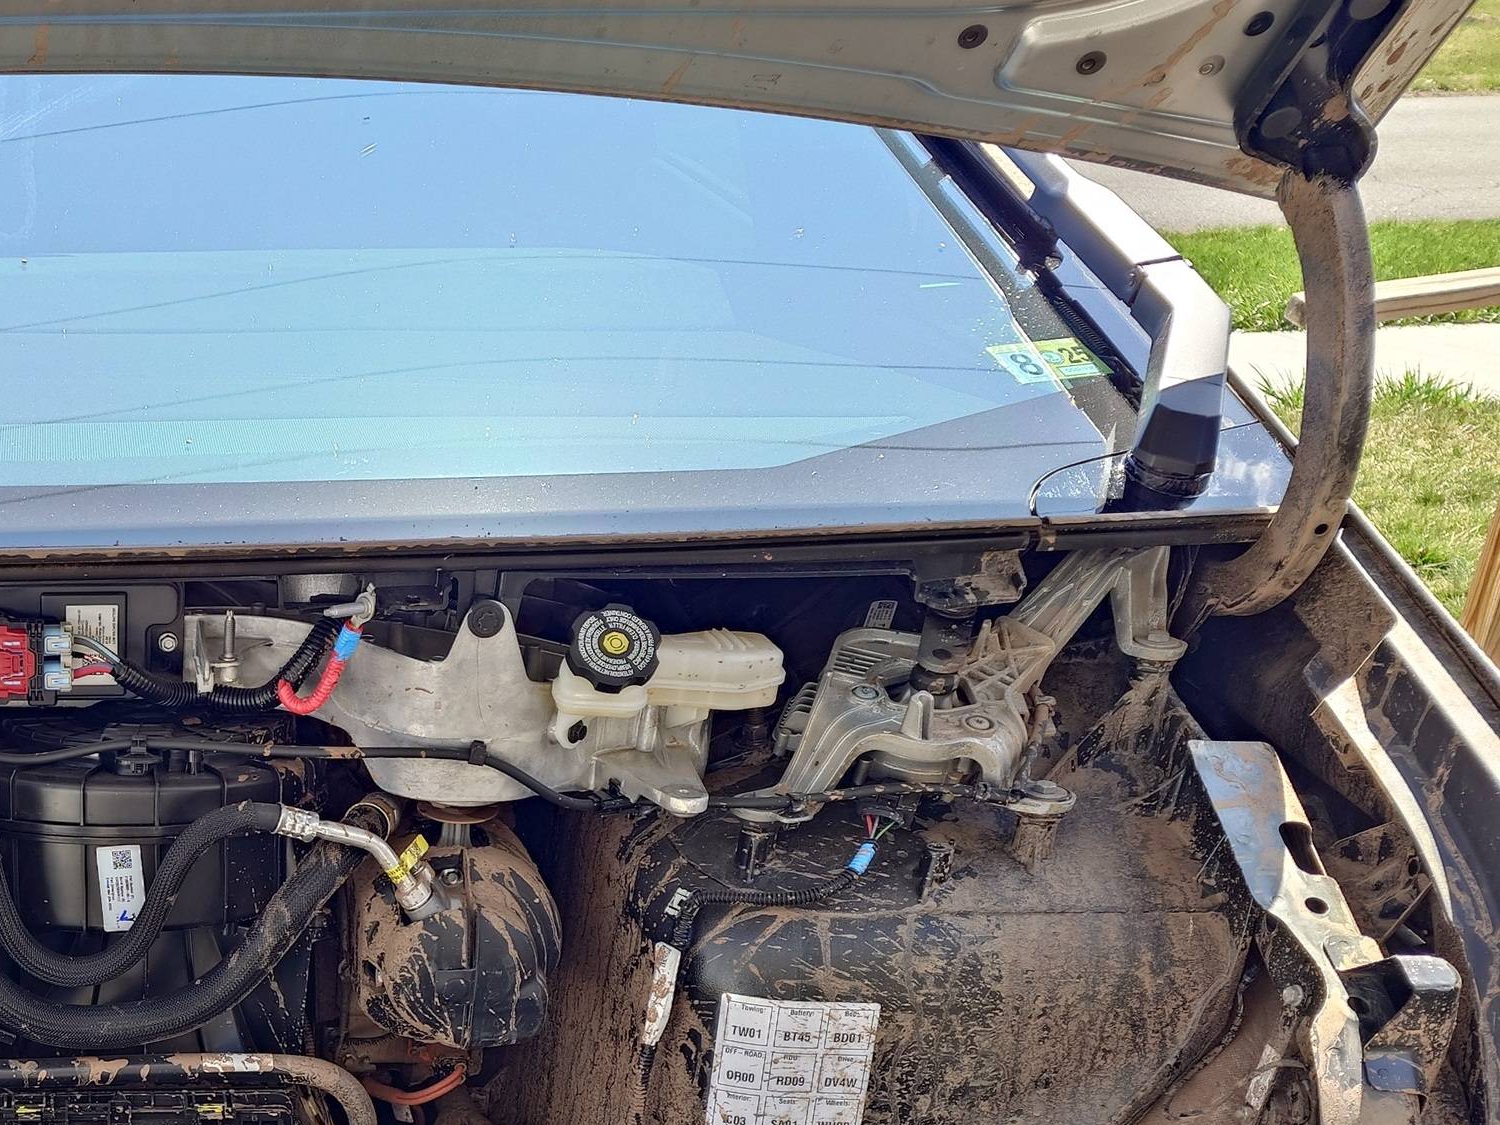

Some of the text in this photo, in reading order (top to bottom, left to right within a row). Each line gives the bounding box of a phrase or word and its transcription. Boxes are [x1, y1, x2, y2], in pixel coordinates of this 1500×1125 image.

[1010, 354, 1044, 375] 8
[731, 1025, 762, 1039] TW01
[783, 1031, 811, 1042] BT45
[833, 1032, 862, 1044] BD01
[776, 1076, 805, 1087] RD09
[824, 1077, 858, 1088] DV4W
